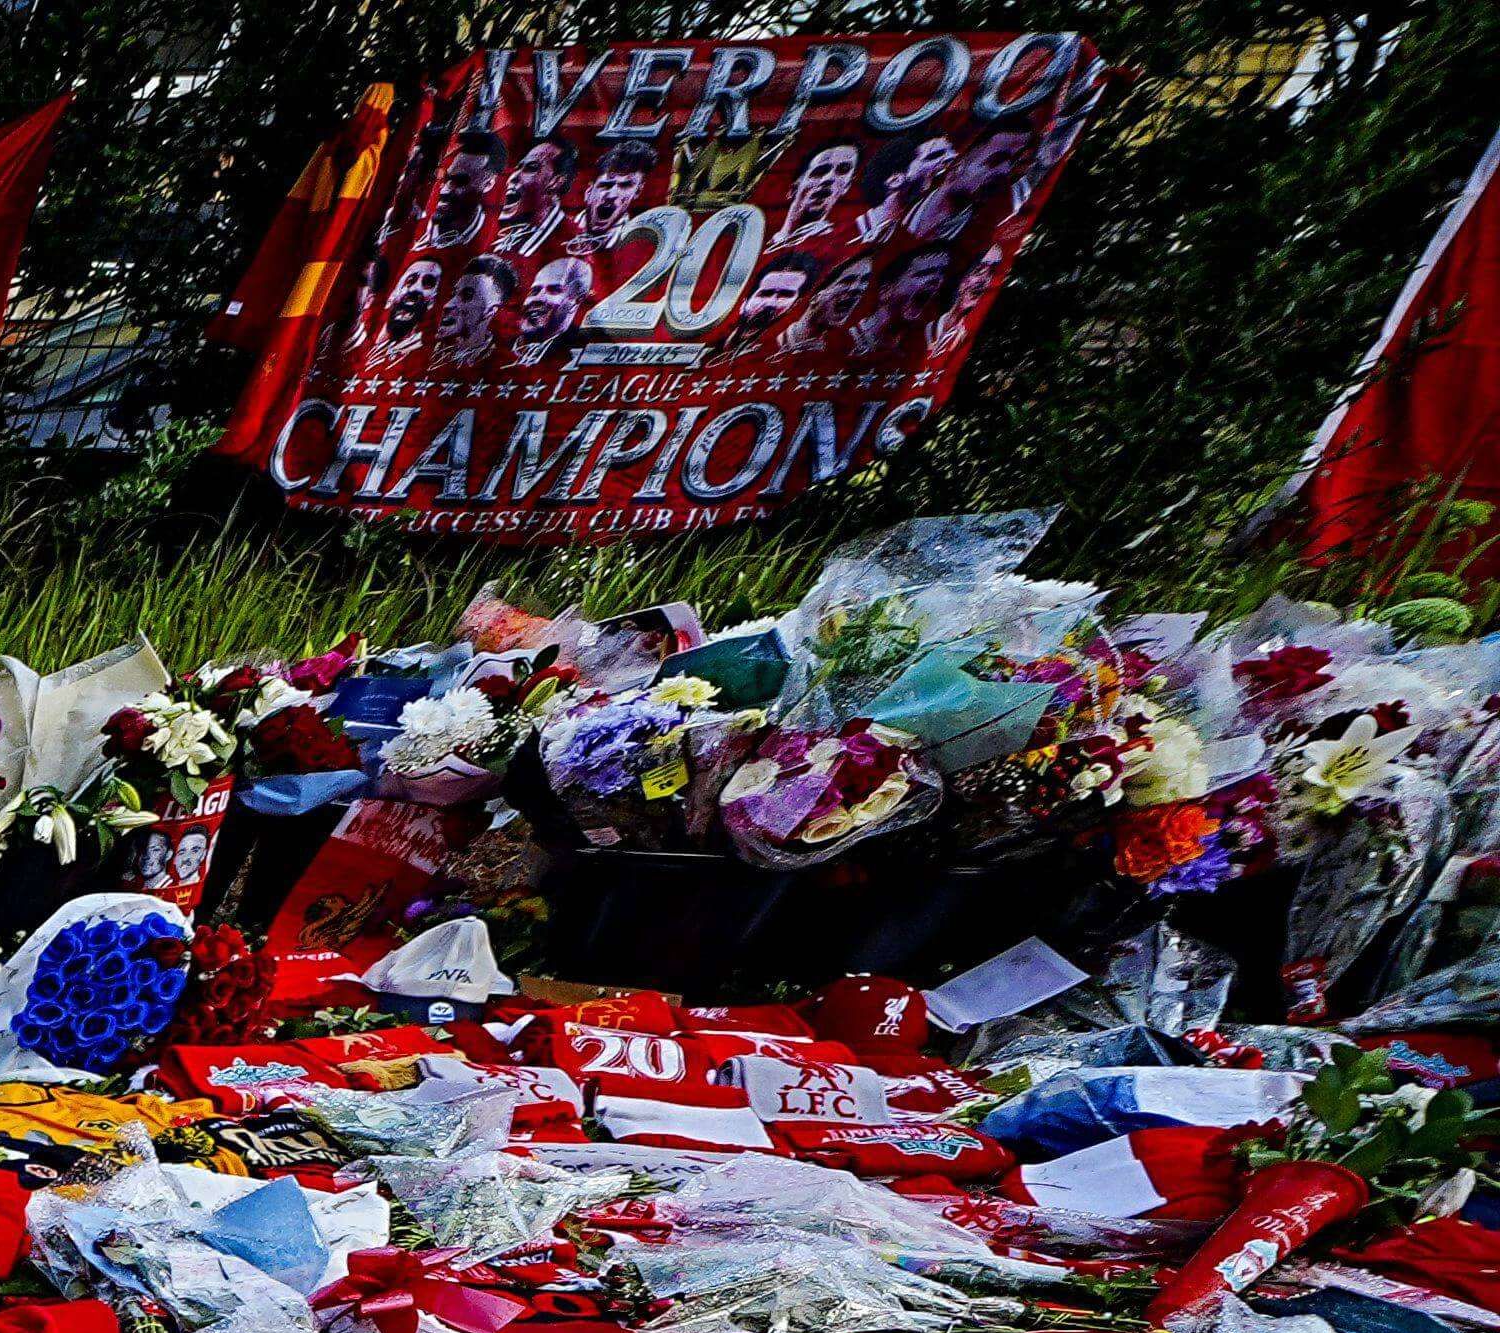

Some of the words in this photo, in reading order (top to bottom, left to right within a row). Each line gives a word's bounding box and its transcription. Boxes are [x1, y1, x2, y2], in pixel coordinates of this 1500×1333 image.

[584, 203, 767, 338] 20
[545, 369, 690, 405] LEAGUE
[588, 506, 675, 535] CLUB
[572, 1025, 686, 1083] 20
[776, 1090, 863, 1122] L.F.C.
